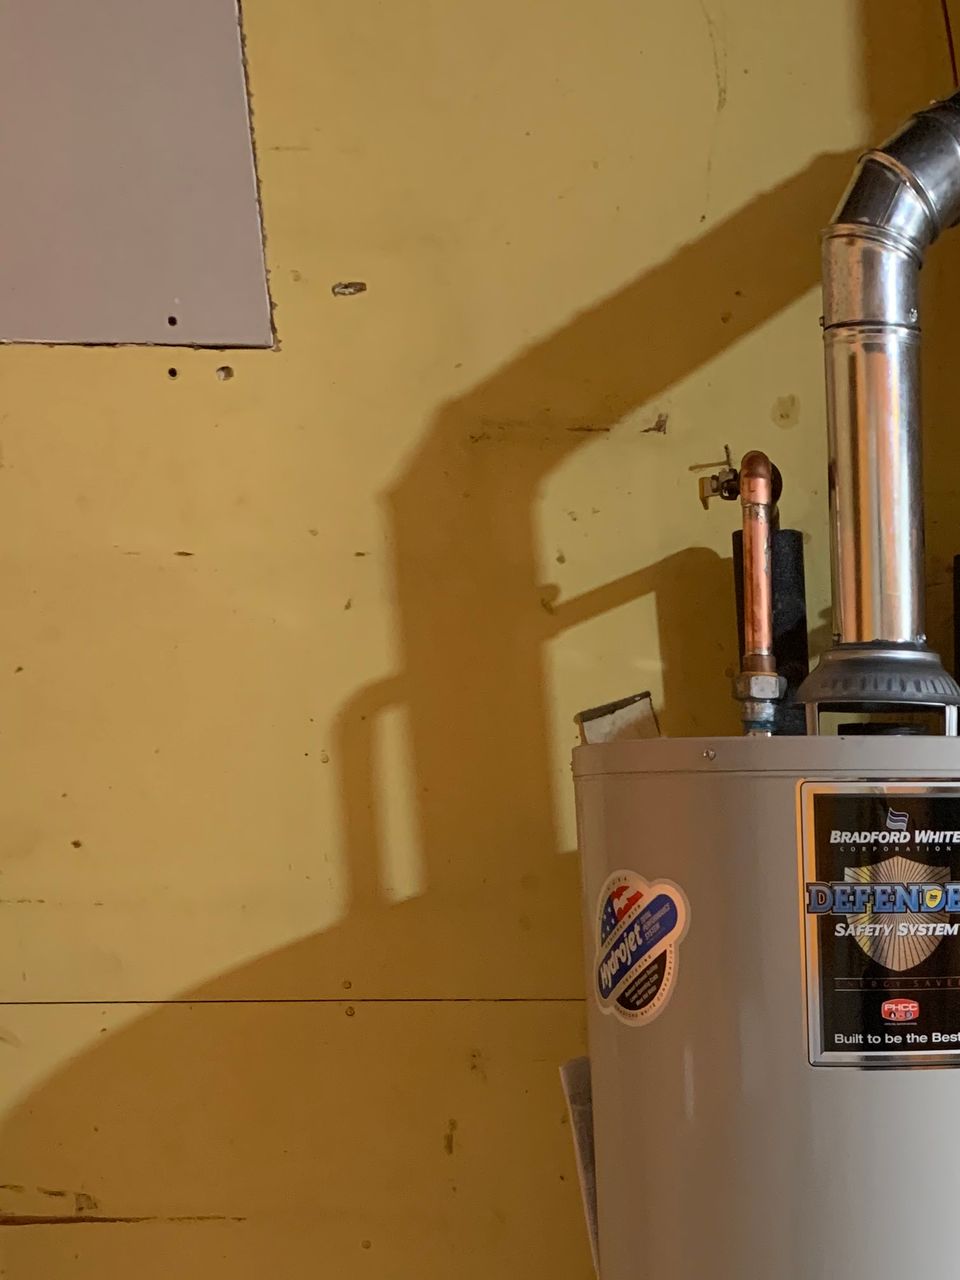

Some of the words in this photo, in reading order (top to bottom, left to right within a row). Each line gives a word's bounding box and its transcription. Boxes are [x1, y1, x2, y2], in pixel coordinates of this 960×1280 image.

[830, 830, 910, 844] BRADFORD
[915, 830, 960, 843] WHITE
[835, 923, 894, 937] SAFETY
[897, 923, 959, 937] SYSTEM
[600, 923, 643, 990] Hydrojet
[884, 1003, 917, 1012] PHCC
[835, 1034, 864, 1044] Built
[867, 1035, 881, 1043] to
[885, 1034, 903, 1043] be
[906, 1033, 928, 1043] the
